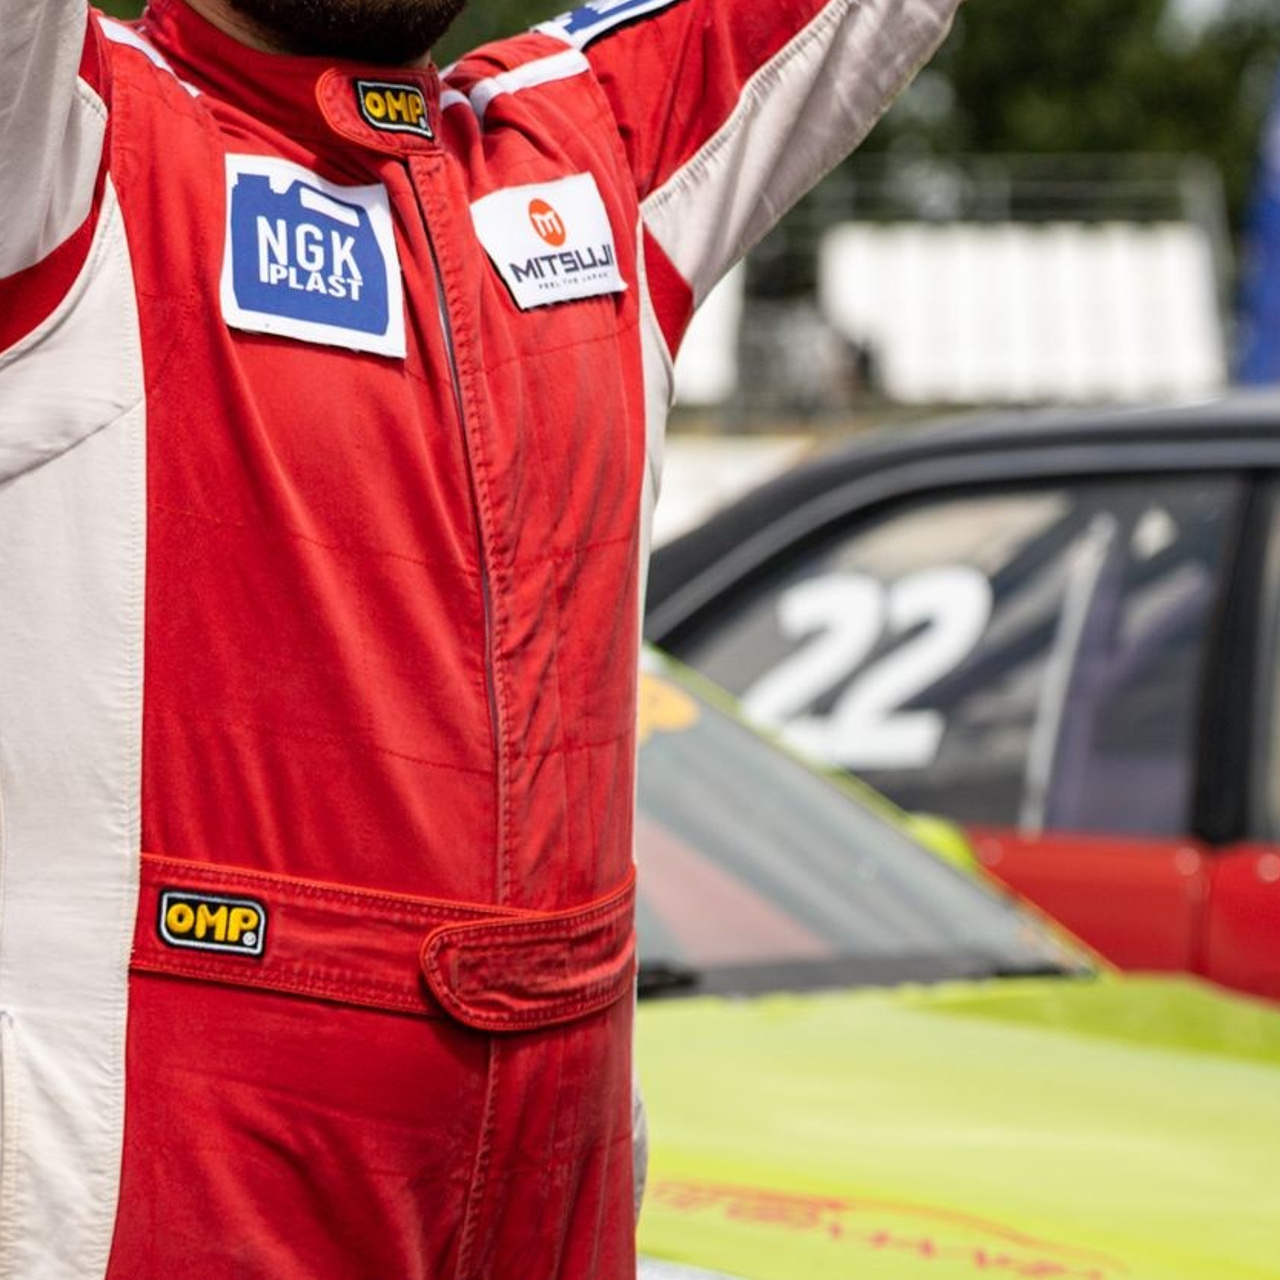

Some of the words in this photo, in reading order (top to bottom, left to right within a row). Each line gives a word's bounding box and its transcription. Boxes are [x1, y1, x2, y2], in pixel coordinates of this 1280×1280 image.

[365, 90, 423, 124] OMP
[256, 215, 362, 283] NGK
[509, 243, 615, 284] MITSUJI
[269, 262, 364, 301] PLAST
[744, 566, 994, 769] 22
[166, 903, 259, 942] OMP
